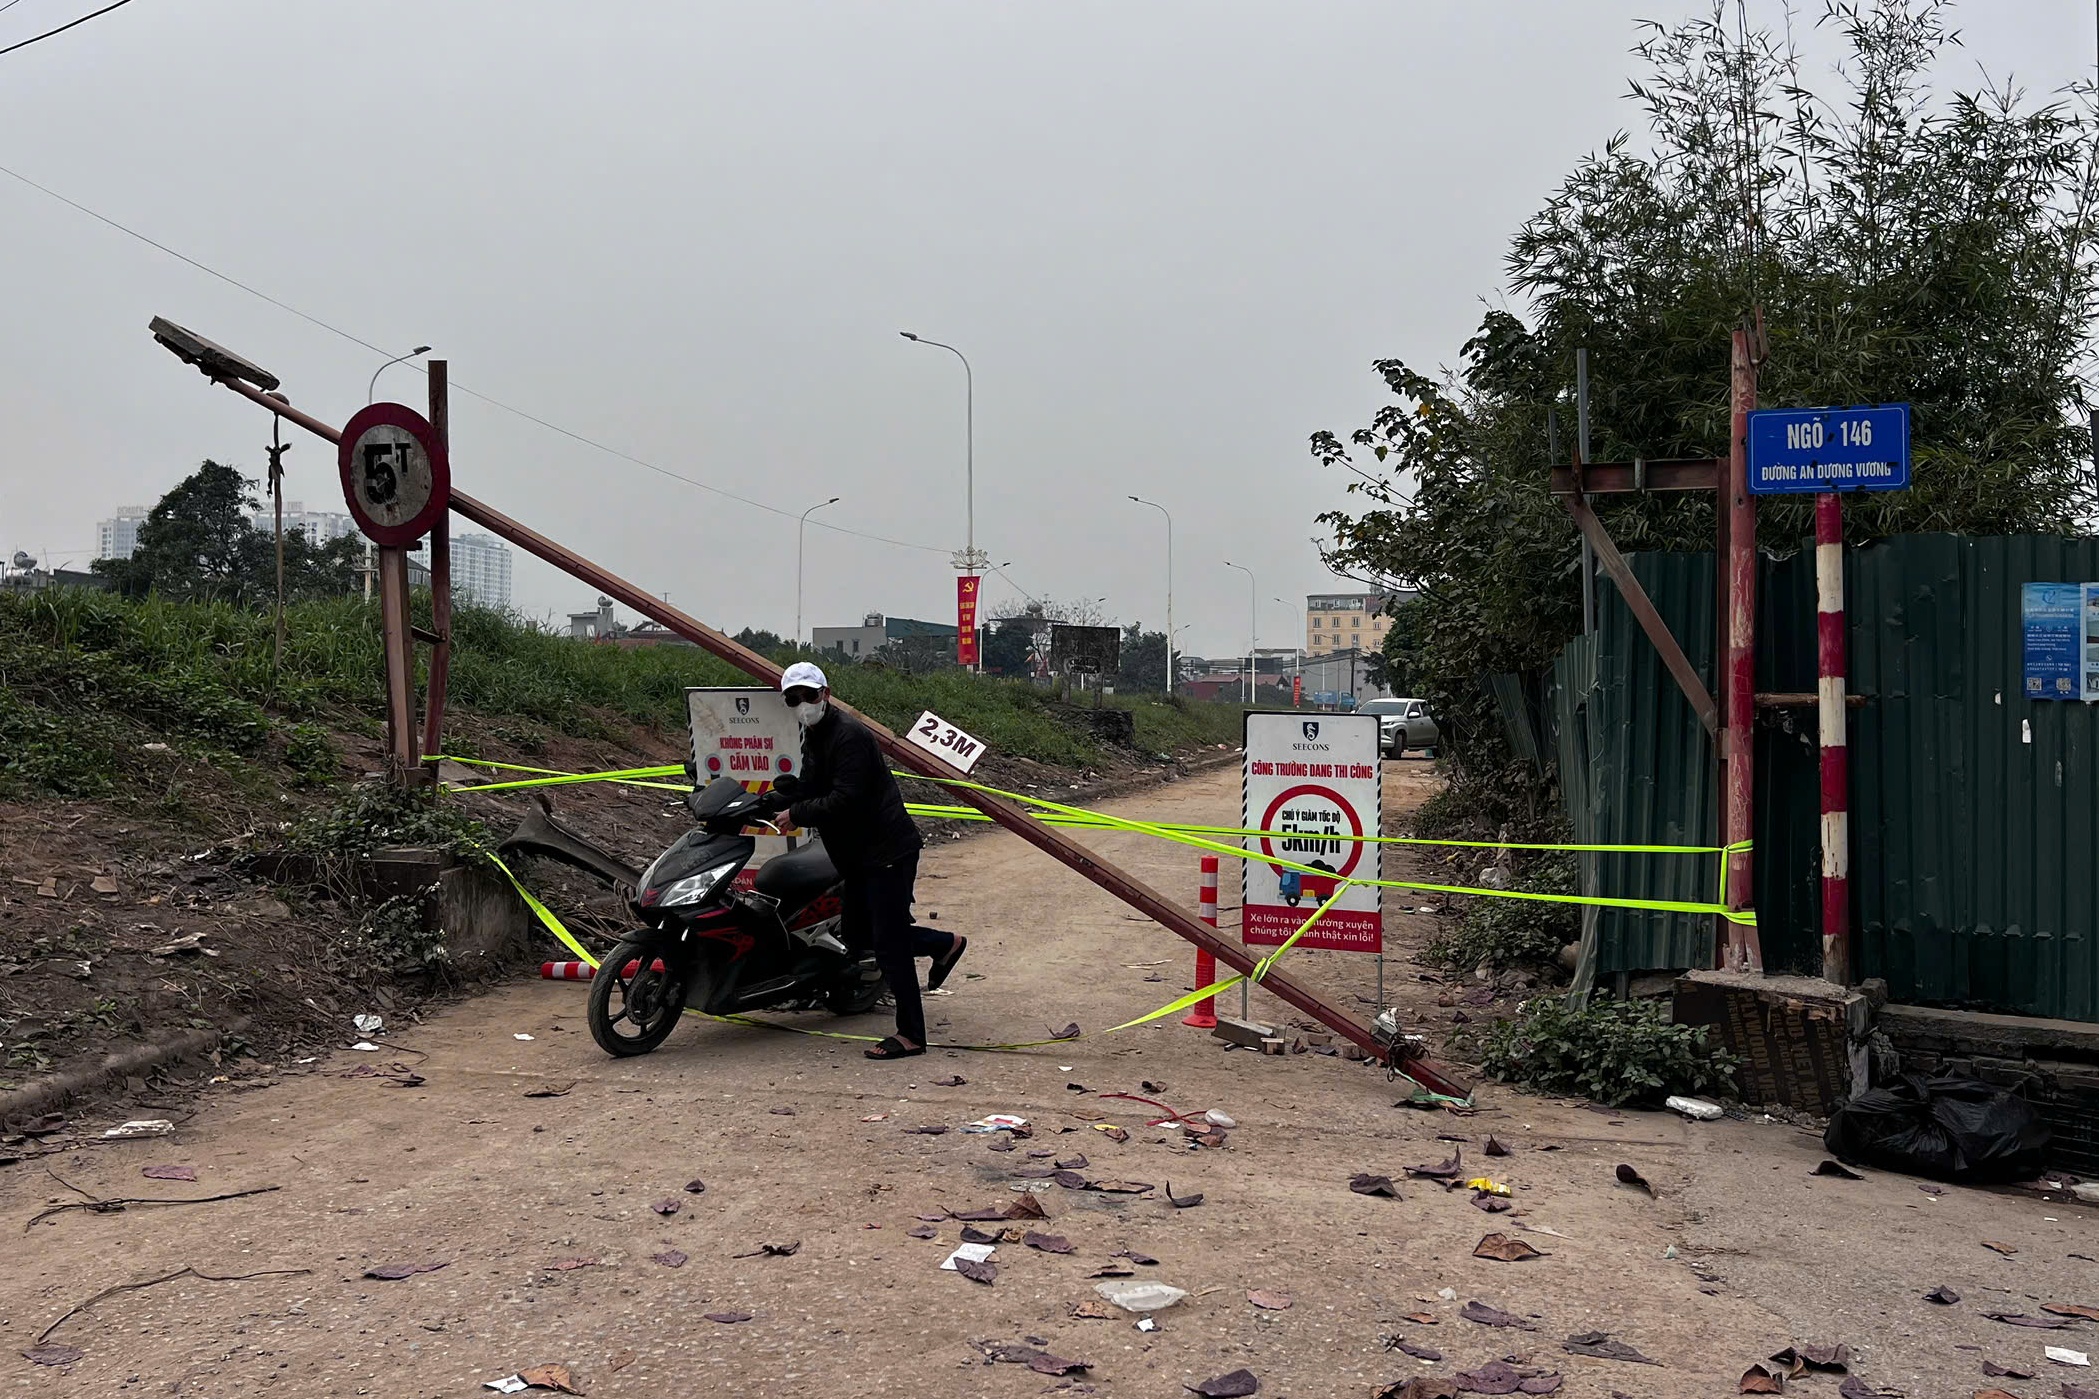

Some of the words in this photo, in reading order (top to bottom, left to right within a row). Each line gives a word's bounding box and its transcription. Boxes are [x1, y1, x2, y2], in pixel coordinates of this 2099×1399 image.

[1787, 417, 1823, 449] NGÕ
[1840, 420, 1871, 446] 146
[1762, 462, 1796, 481] ĐƯỜNG
[1800, 466, 1814, 479] AN
[1818, 463, 1852, 479] DƯƠNG
[1856, 462, 1891, 477] VƯƠNG
[919, 718, 977, 758] 2,3M
[1292, 743, 1329, 751] SEECONS
[751, 752, 769, 770] VÀO
[1252, 760, 1273, 775] CÔNG
[1276, 760, 1307, 777] TRƯỜNG
[1334, 765, 1347, 778] THI
[1350, 762, 1372, 779] CÔNG
[1282, 824, 1340, 855] 5km/h
[1250, 914, 1262, 922] Xe
[1264, 914, 1278, 923] lớn
[1312, 919, 1343, 929] ường
[1346, 920, 1373, 930] xuyên
[1250, 926, 1277, 937] chúng
[1279, 927, 1291, 936] tôi
[1343, 932, 1357, 941] xin
